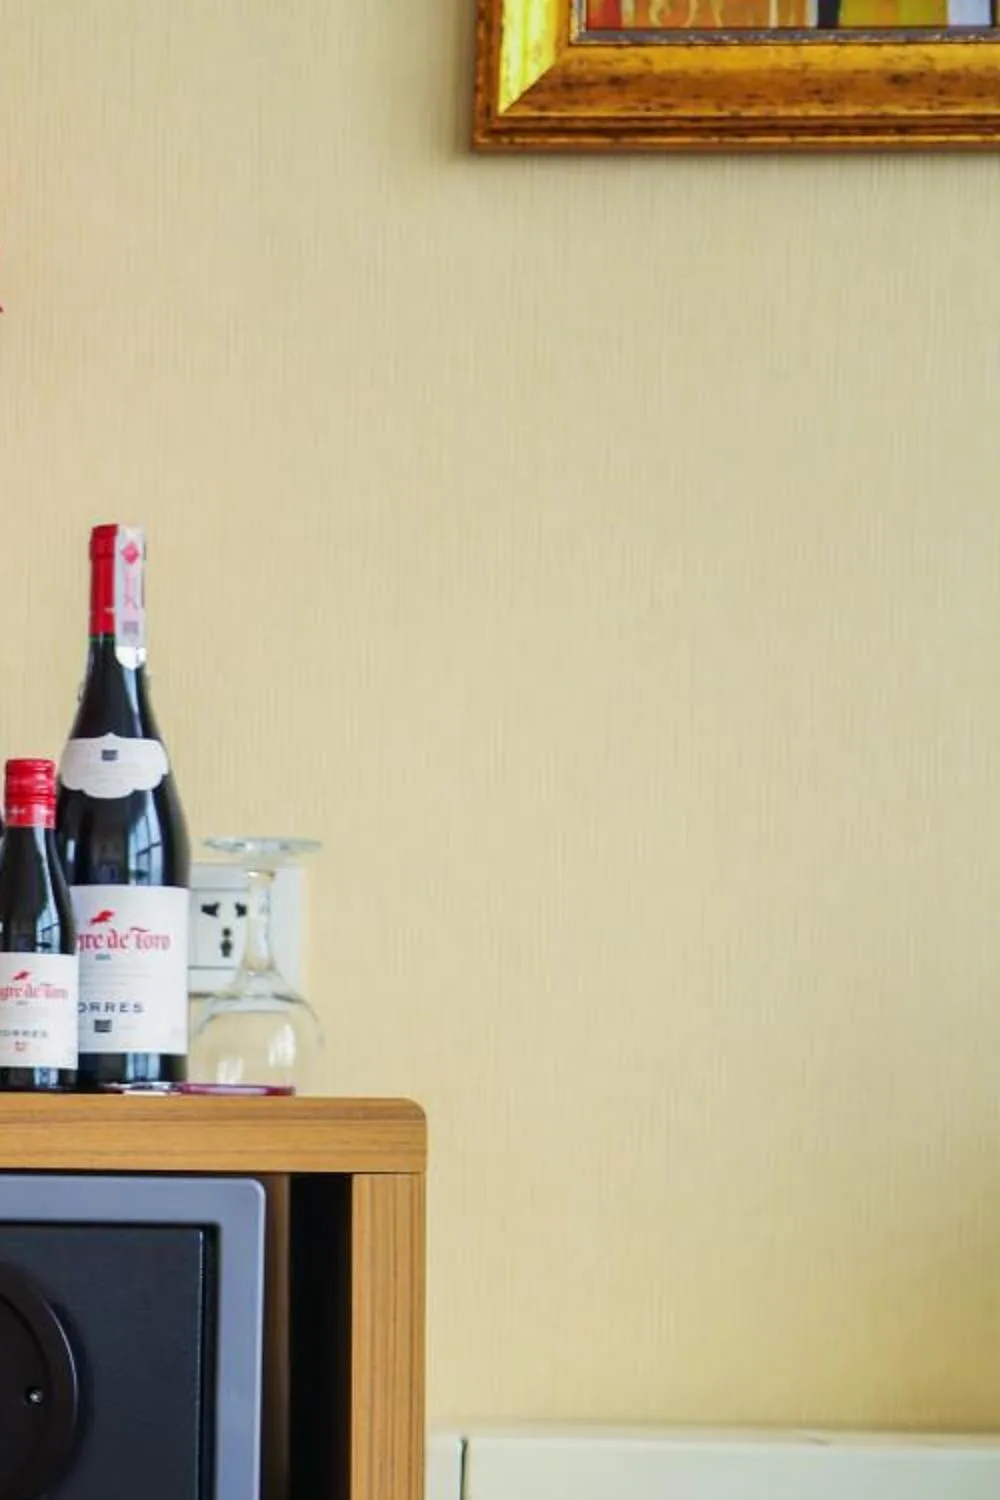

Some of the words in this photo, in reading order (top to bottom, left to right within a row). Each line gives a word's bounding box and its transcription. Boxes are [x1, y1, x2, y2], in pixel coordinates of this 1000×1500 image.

[109, 930, 130, 950] de
[131, 927, 171, 950] Toro
[24, 983, 40, 999] de
[78, 1001, 144, 1013] ORRES
